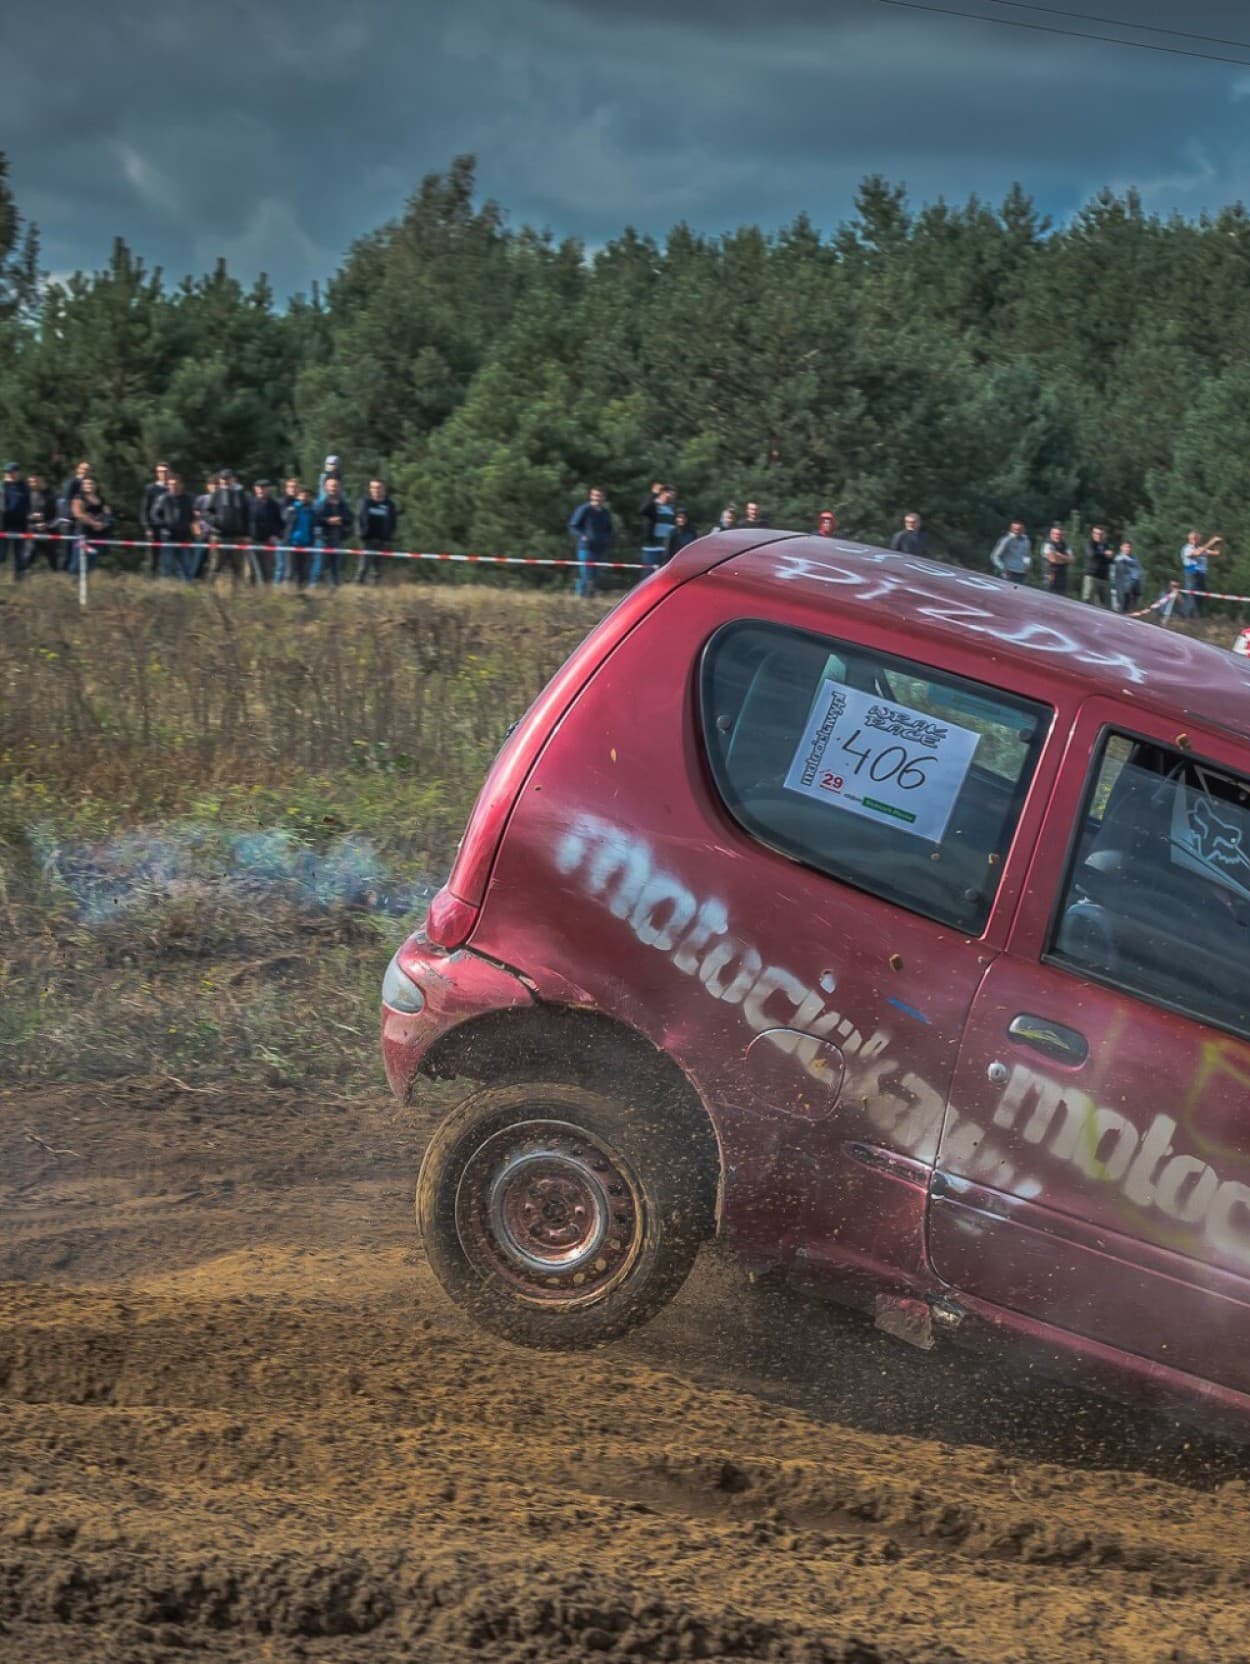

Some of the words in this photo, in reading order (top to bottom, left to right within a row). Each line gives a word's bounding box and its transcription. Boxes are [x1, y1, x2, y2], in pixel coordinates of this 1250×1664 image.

[863, 715, 943, 749] RACE
[841, 729, 938, 790] 406
[820, 771, 845, 789] 29
